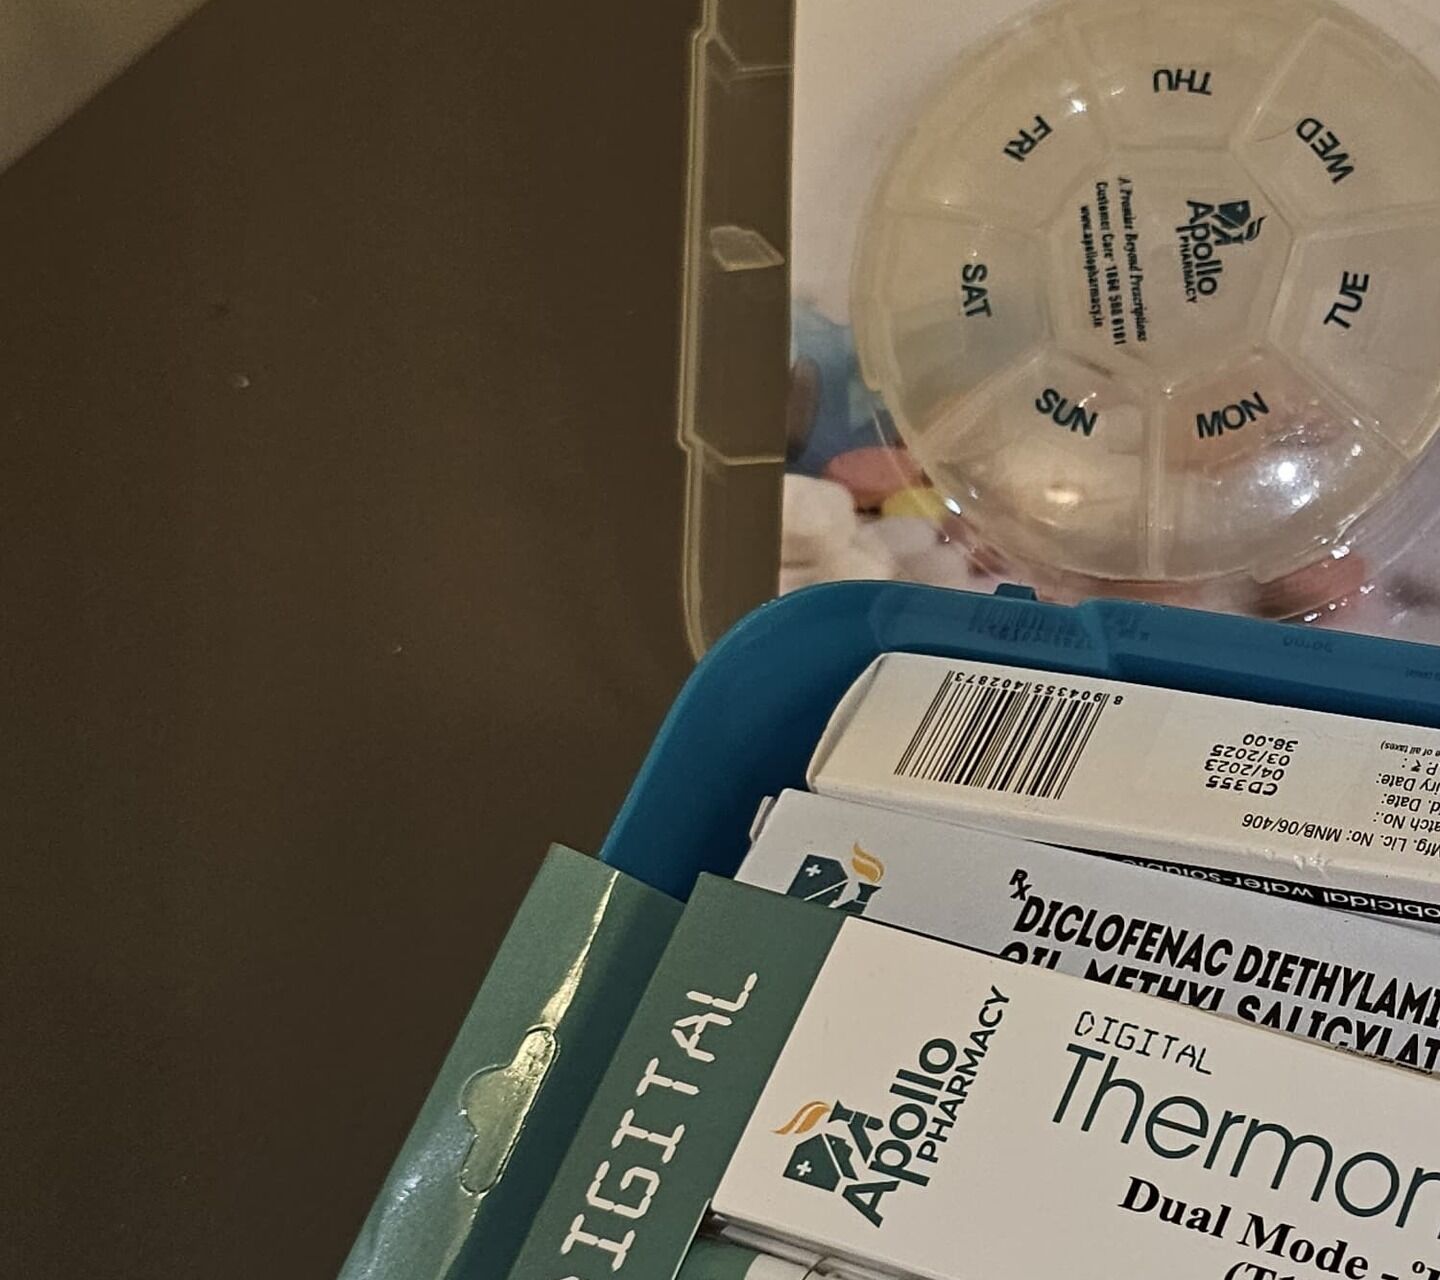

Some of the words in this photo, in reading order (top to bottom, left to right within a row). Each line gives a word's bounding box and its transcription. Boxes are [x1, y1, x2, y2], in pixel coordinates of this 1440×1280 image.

[1153, 69, 1212, 95] THU
[1003, 116, 1052, 162] FRI
[1295, 118, 1355, 183] WED
[1175, 200, 1222, 296] Apollo
[1179, 236, 1197, 303] PHARMACY
[961, 263, 991, 317] SAT
[1323, 272, 1369, 329] TUE
[1035, 389, 1098, 437] SUN
[1196, 392, 1270, 438] MON
[1204, 758, 1285, 781] 04/2023
[1209, 743, 1290, 767] 03/2025
[1242, 733, 1298, 752] 38.00
[1376, 773, 1416, 792] Date:
[1241, 813, 1343, 843] MNB/06/406
[1013, 895, 1233, 976] DICLOFENAC
[1073, 1010, 1215, 1076] DIGITAL
[914, 985, 1012, 1164] PHARMACY
[841, 1036, 959, 1228] Apollo
[1117, 1174, 1232, 1241] Dual
